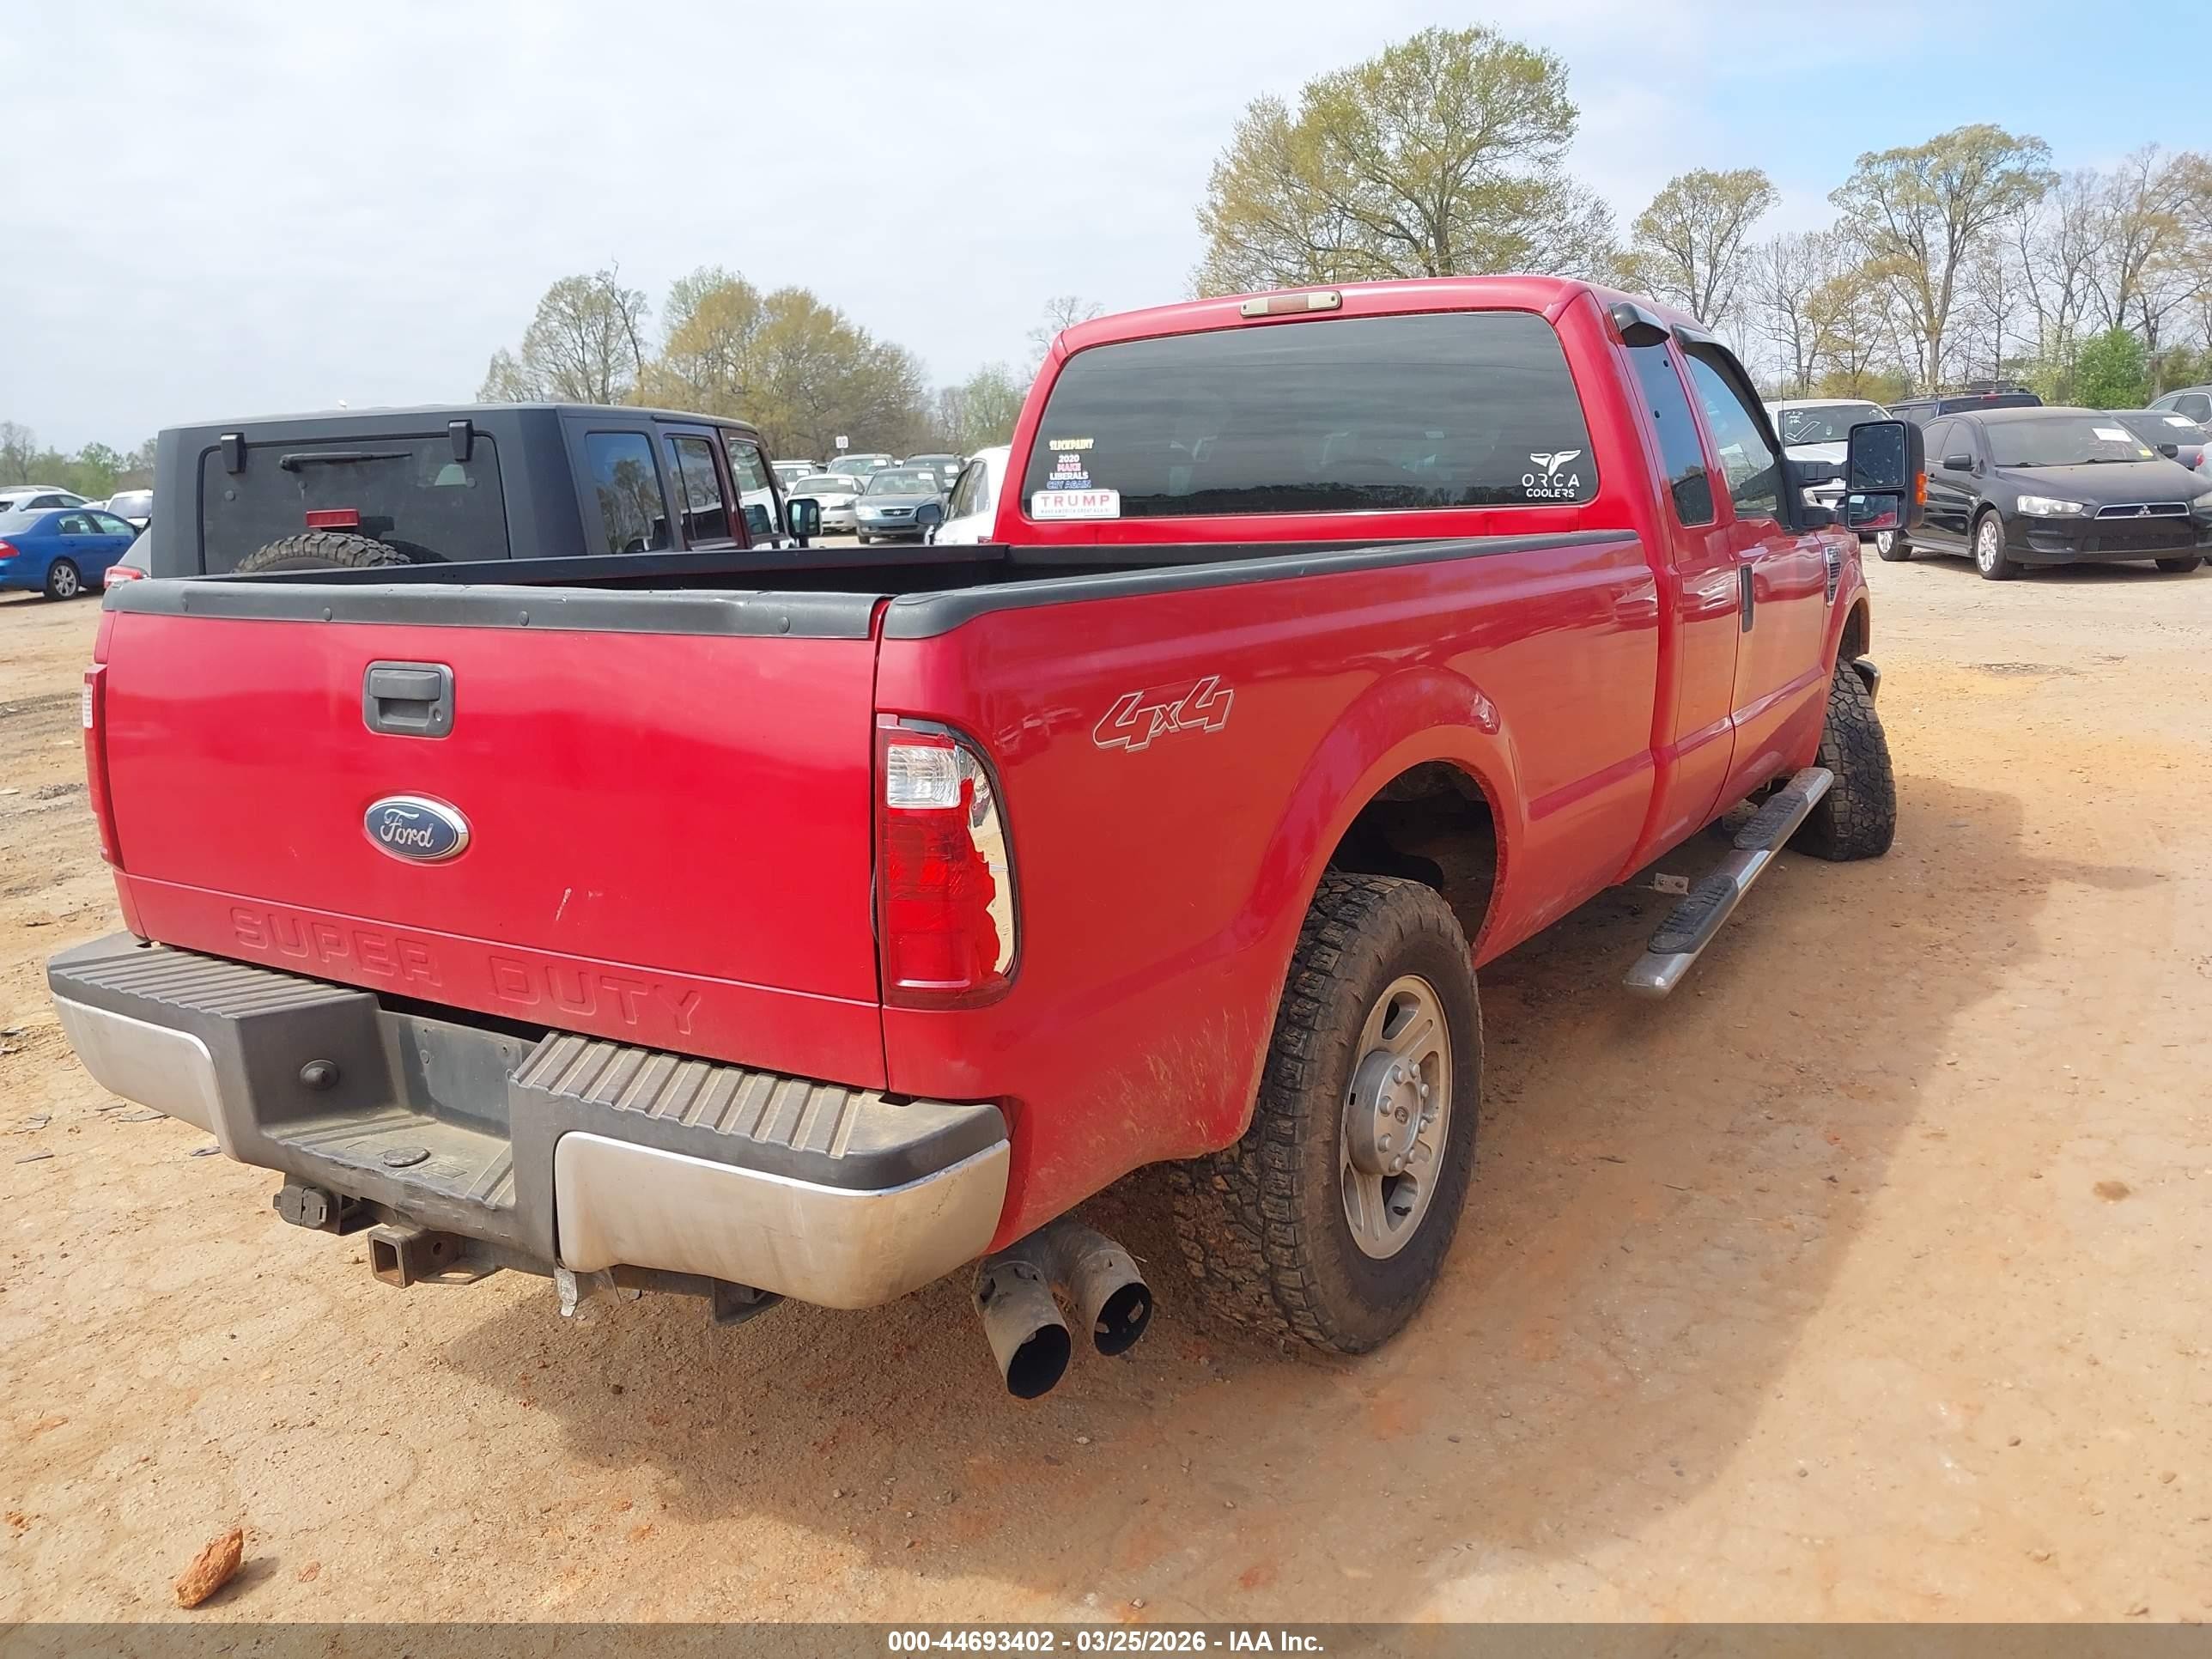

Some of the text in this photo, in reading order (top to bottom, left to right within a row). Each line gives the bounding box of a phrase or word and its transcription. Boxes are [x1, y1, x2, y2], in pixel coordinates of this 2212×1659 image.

[1058, 454, 1080, 463] 2020
[1049, 471, 1088, 480] LIBERALS
[1522, 473, 1580, 487] ORCA
[1526, 489, 1575, 497] COOLERS
[1040, 495, 1109, 507] TRUMP
[380, 808, 434, 848] Ford
[230, 906, 702, 1035] SUPER DUTY
